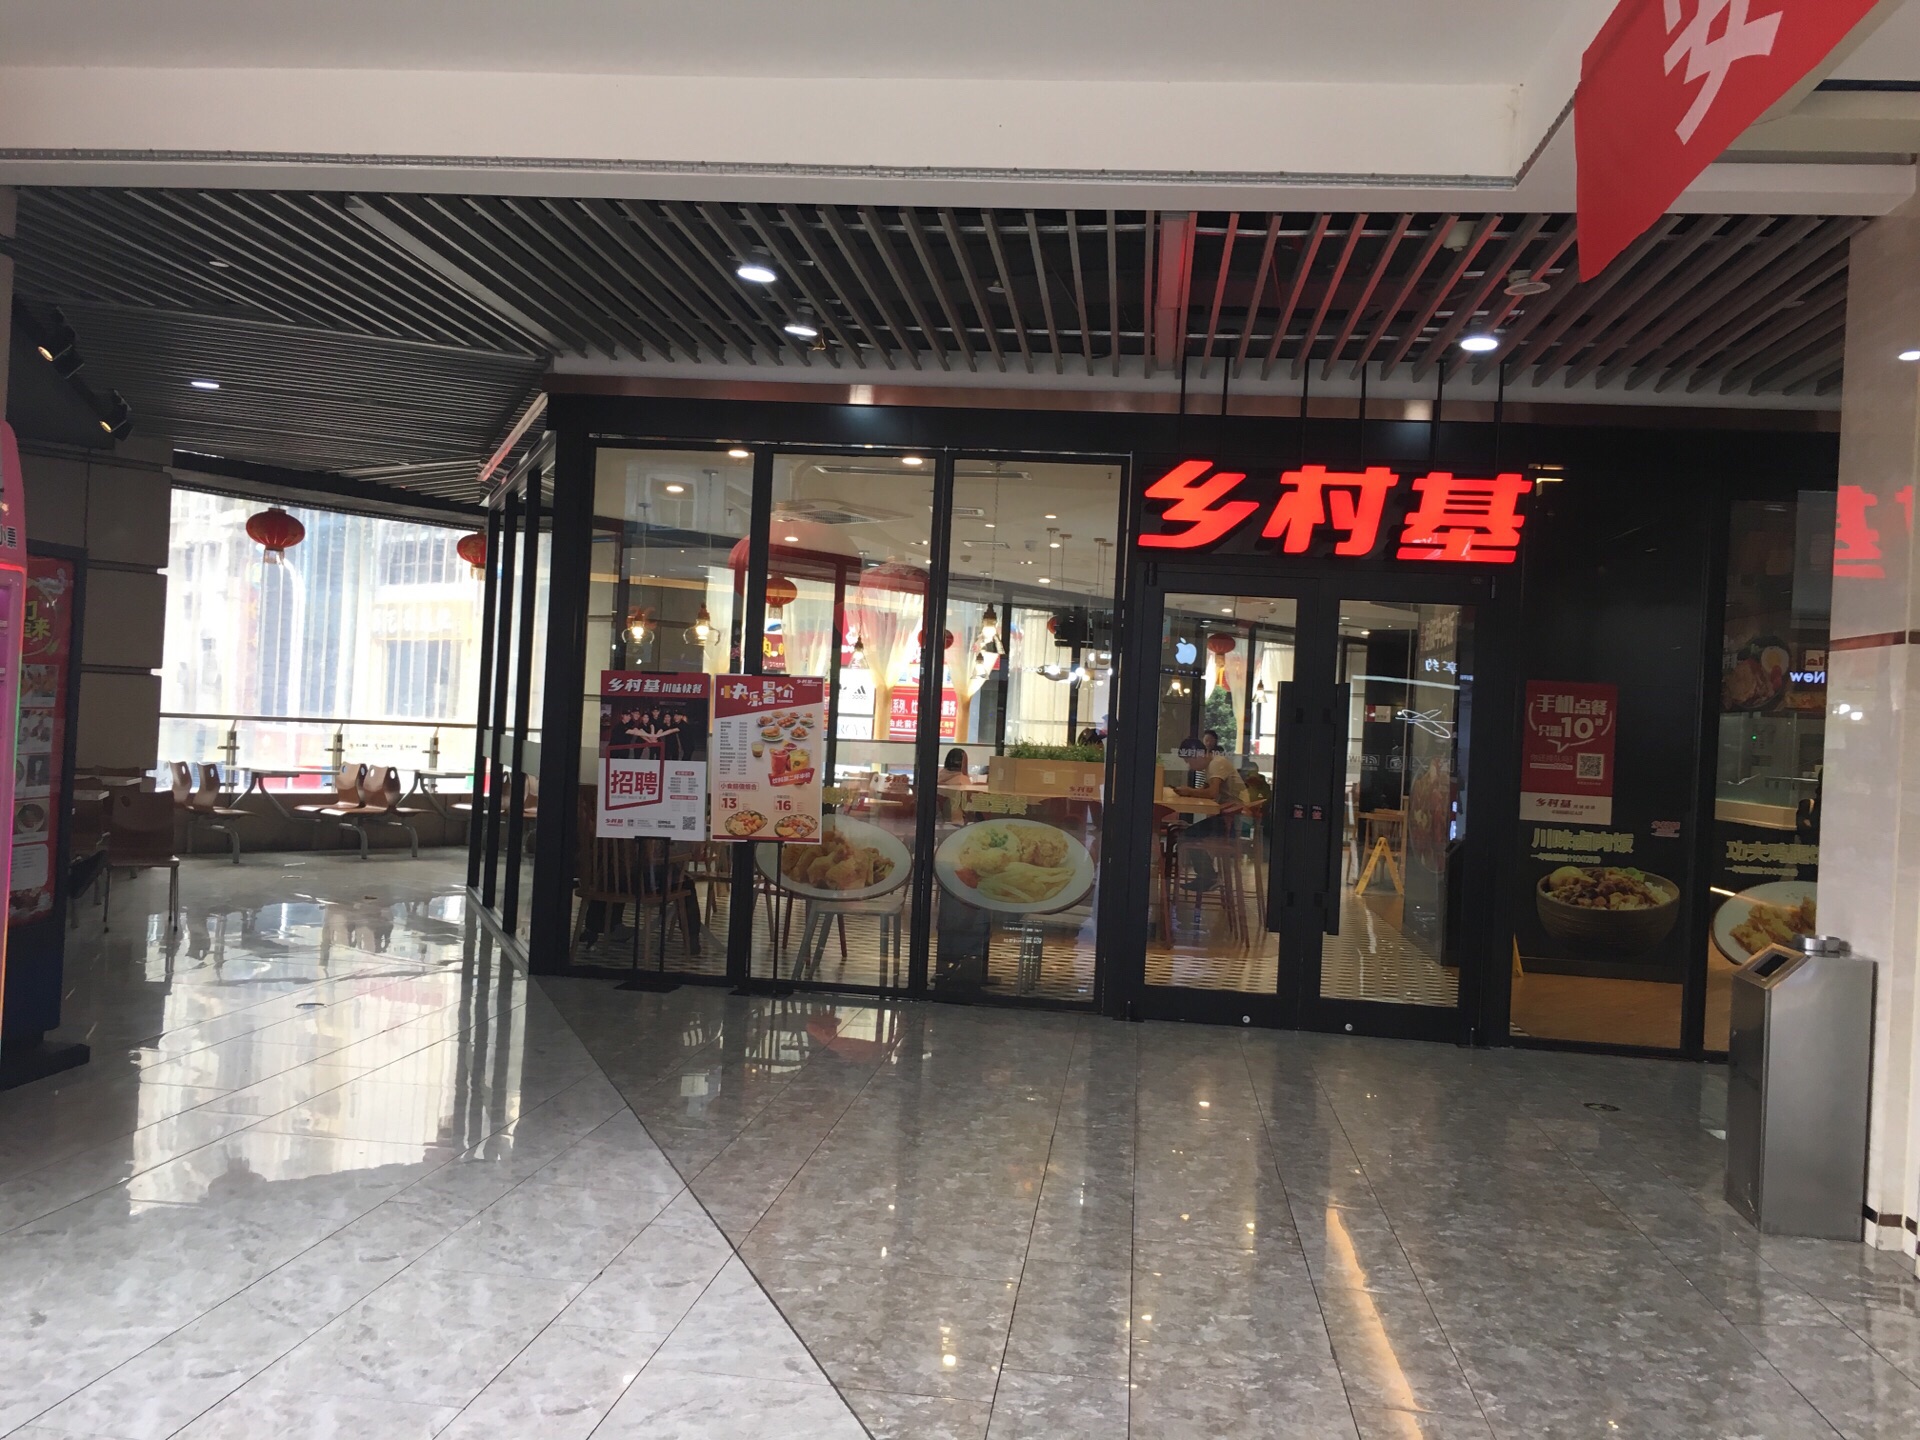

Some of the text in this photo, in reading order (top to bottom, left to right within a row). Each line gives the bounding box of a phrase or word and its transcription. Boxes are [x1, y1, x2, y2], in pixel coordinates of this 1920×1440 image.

[1138, 459, 1533, 563] 乡村基
[608, 677, 703, 694] 乡村基 川味快餐
[720, 680, 795, 707] 快乐暑价
[1536, 694, 1608, 716] 手机点餐
[610, 769, 658, 795] 招聘
[1536, 797, 1572, 808] 乡村基
[1531, 828, 1635, 854] 川味卤肉饭
